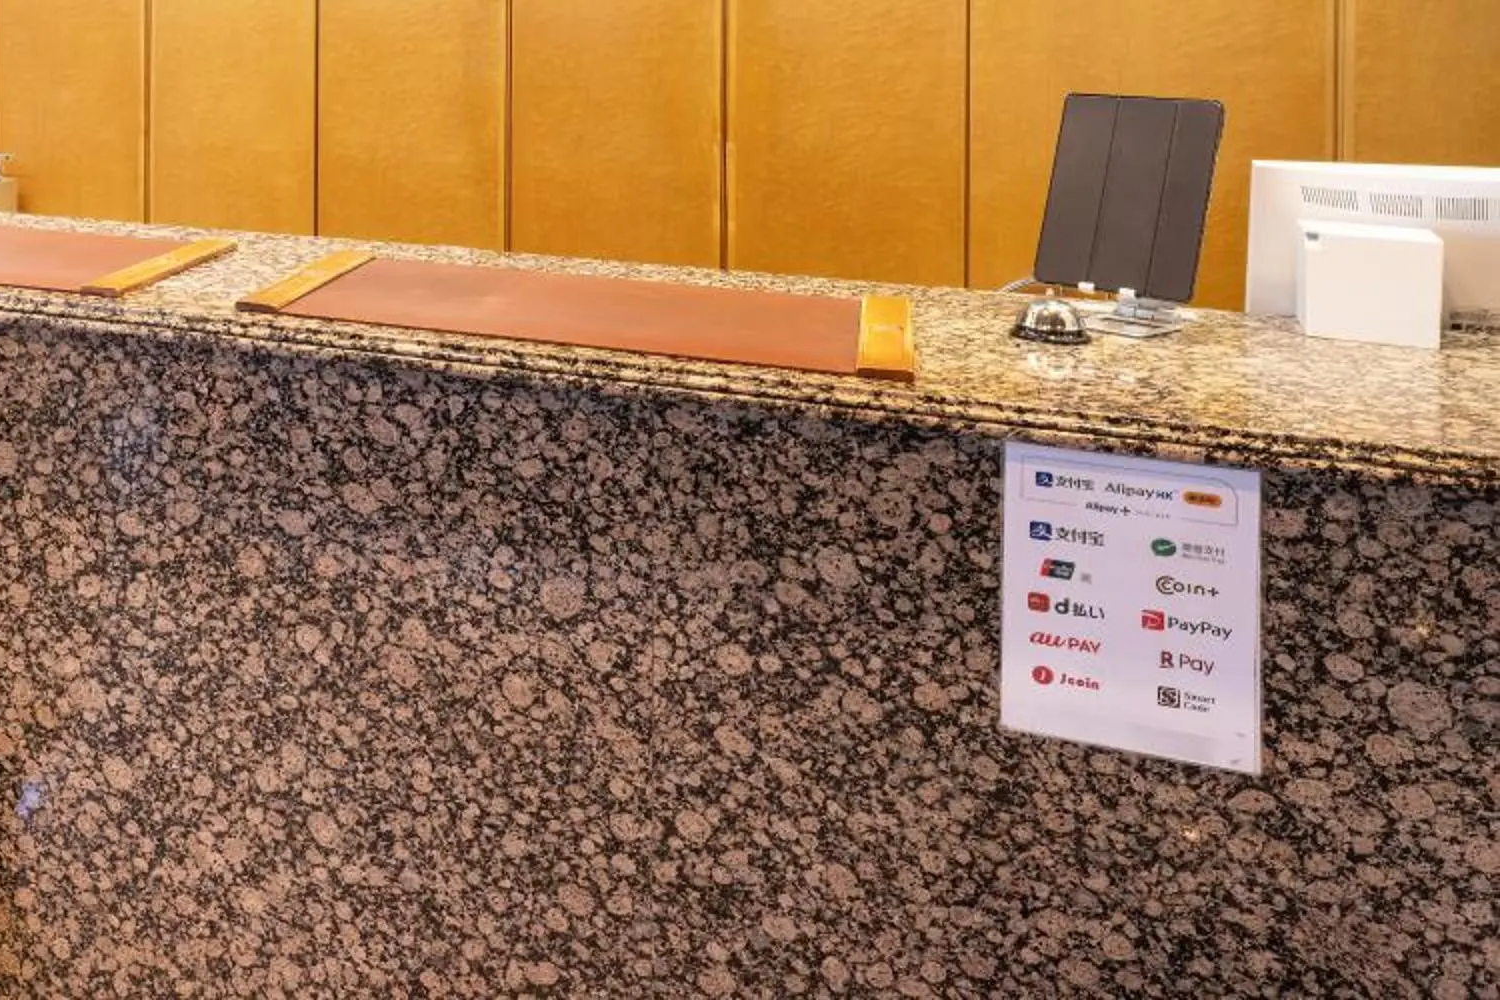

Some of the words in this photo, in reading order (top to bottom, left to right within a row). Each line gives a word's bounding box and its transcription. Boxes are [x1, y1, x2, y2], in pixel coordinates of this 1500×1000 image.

[1054, 598, 1105, 619] d払い
[1167, 616, 1233, 641] PayPay
[1068, 637, 1102, 654] PAY
[1159, 650, 1174, 669] R
[1178, 653, 1215, 676] Pay
